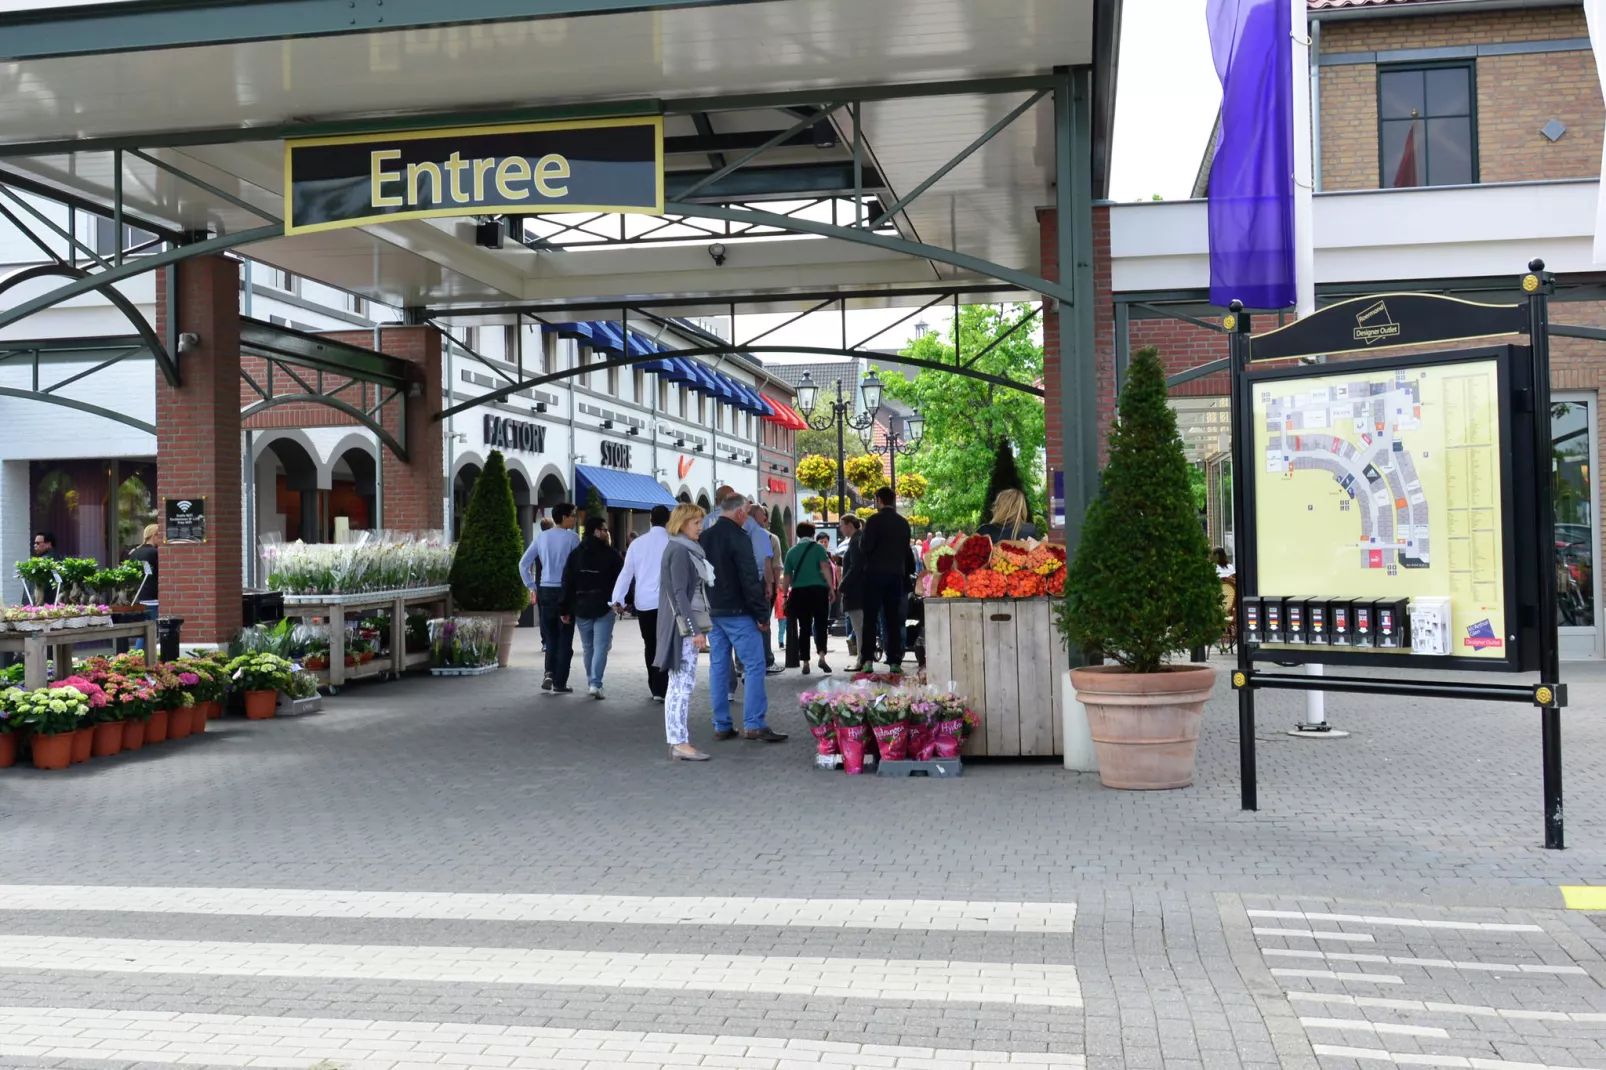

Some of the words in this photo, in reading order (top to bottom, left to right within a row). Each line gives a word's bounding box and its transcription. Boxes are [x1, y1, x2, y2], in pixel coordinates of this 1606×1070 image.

[370, 150, 571, 208] Entree
[1356, 329, 1380, 338] Designer
[1380, 326, 1397, 334] Outlet
[483, 413, 547, 453] FACTORY
[600, 440, 633, 469] STORE
